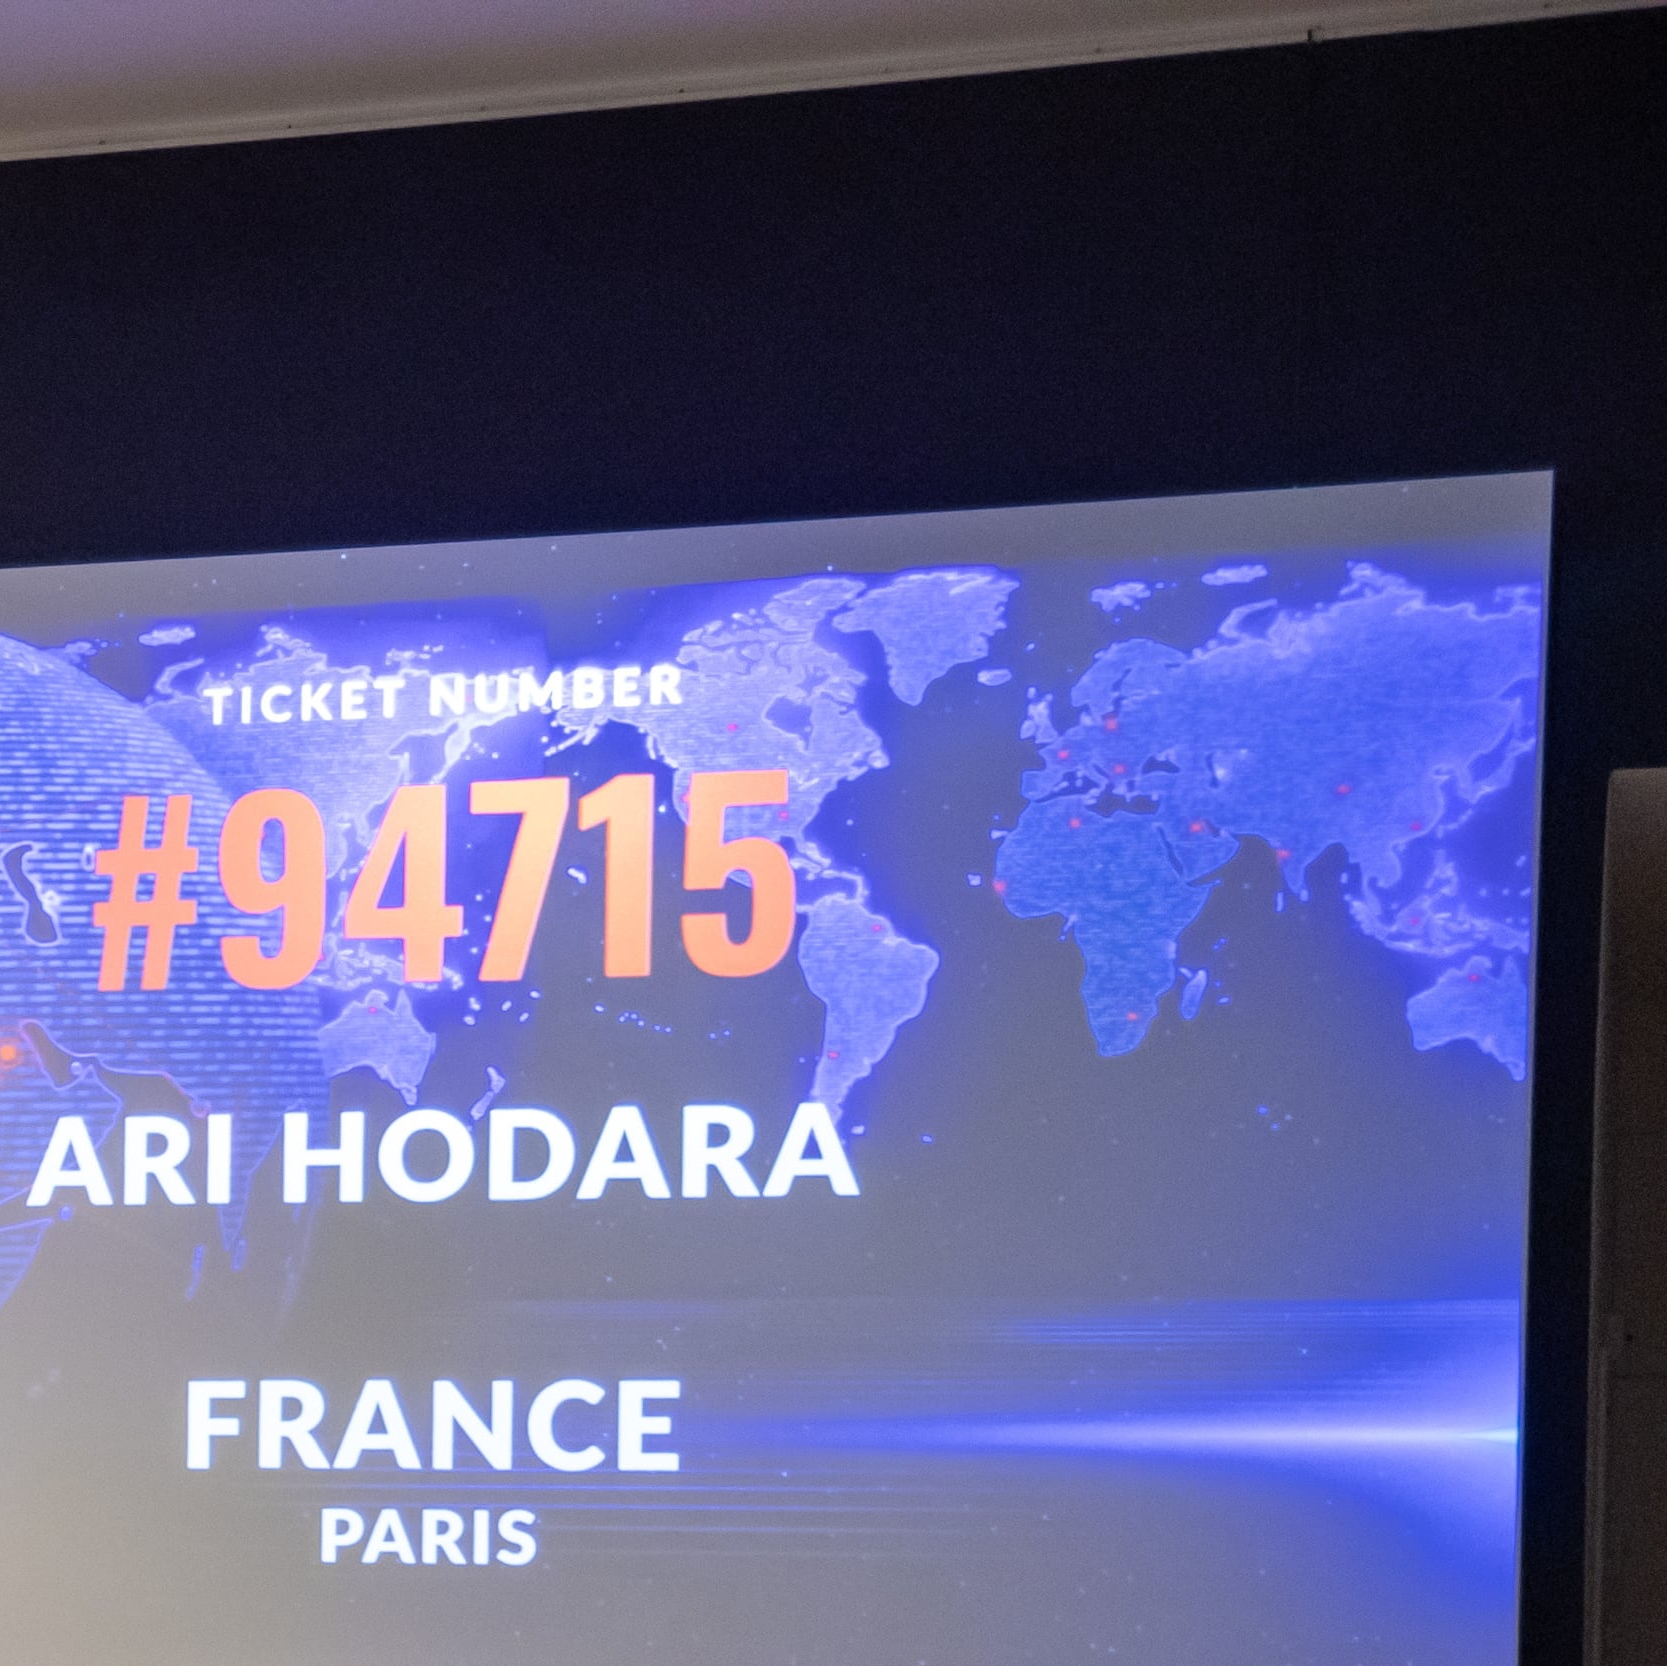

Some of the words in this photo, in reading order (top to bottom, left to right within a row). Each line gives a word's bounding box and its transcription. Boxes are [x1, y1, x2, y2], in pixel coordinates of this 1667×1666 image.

[203, 676, 407, 726] TICKET
[428, 664, 683, 719] NUMBER
[92, 768, 797, 993] #94715
[25, 1112, 233, 1207] ARI
[282, 1102, 862, 1205] HODARA
[185, 1378, 681, 1472] FRANCE
[319, 1507, 538, 1566] PARIS
